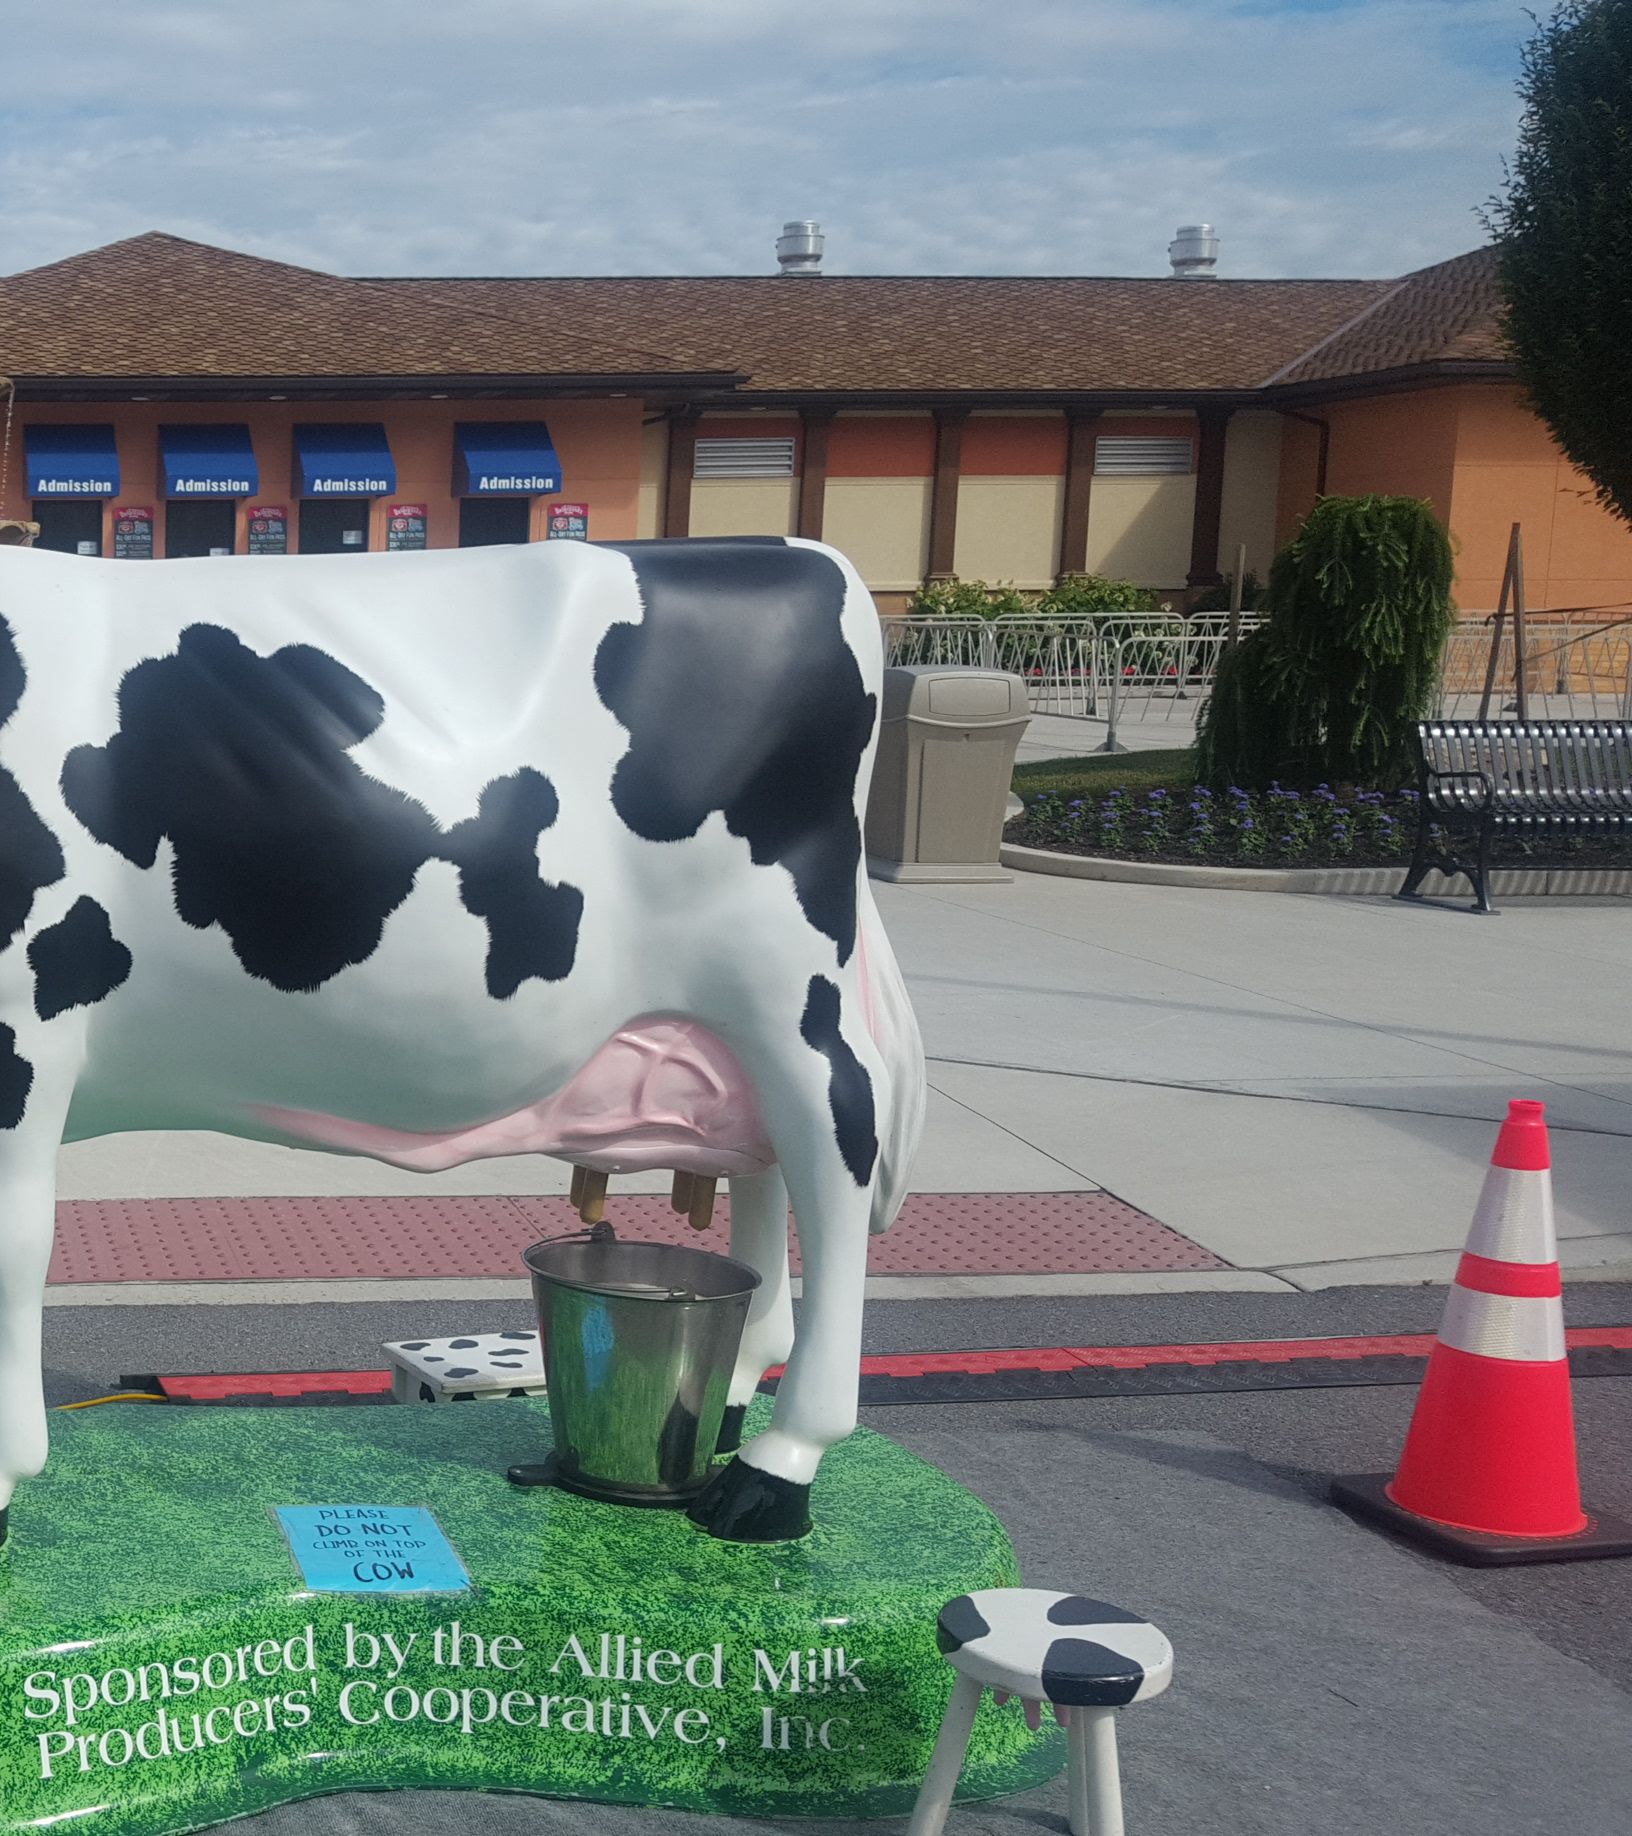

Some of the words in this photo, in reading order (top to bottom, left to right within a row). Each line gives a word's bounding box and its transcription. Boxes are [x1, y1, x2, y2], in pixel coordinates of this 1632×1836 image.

[37, 479, 112, 492] Admission
[175, 479, 249, 492] Admission
[312, 478, 387, 492] Admission
[479, 476, 554, 490] Admission
[319, 1509, 389, 1520] PLEASE
[315, 1524, 351, 1537] DO
[361, 1523, 413, 1536] NOT
[364, 1540, 387, 1548] ON
[392, 1539, 427, 1549] TOP
[344, 1550, 364, 1559] OF
[373, 1549, 406, 1559] THE
[353, 1561, 414, 1583] COW
[22, 1624, 317, 1725] Sponsored
[344, 1622, 418, 1679] by
[432, 1621, 525, 1671] the
[550, 1633, 724, 1690] Allied
[752, 1646, 869, 1694] Milk
[36, 1676, 319, 1780] Producers'
[338, 1679, 726, 1754] Cooperative,
[759, 1706, 866, 1752] Inc.
